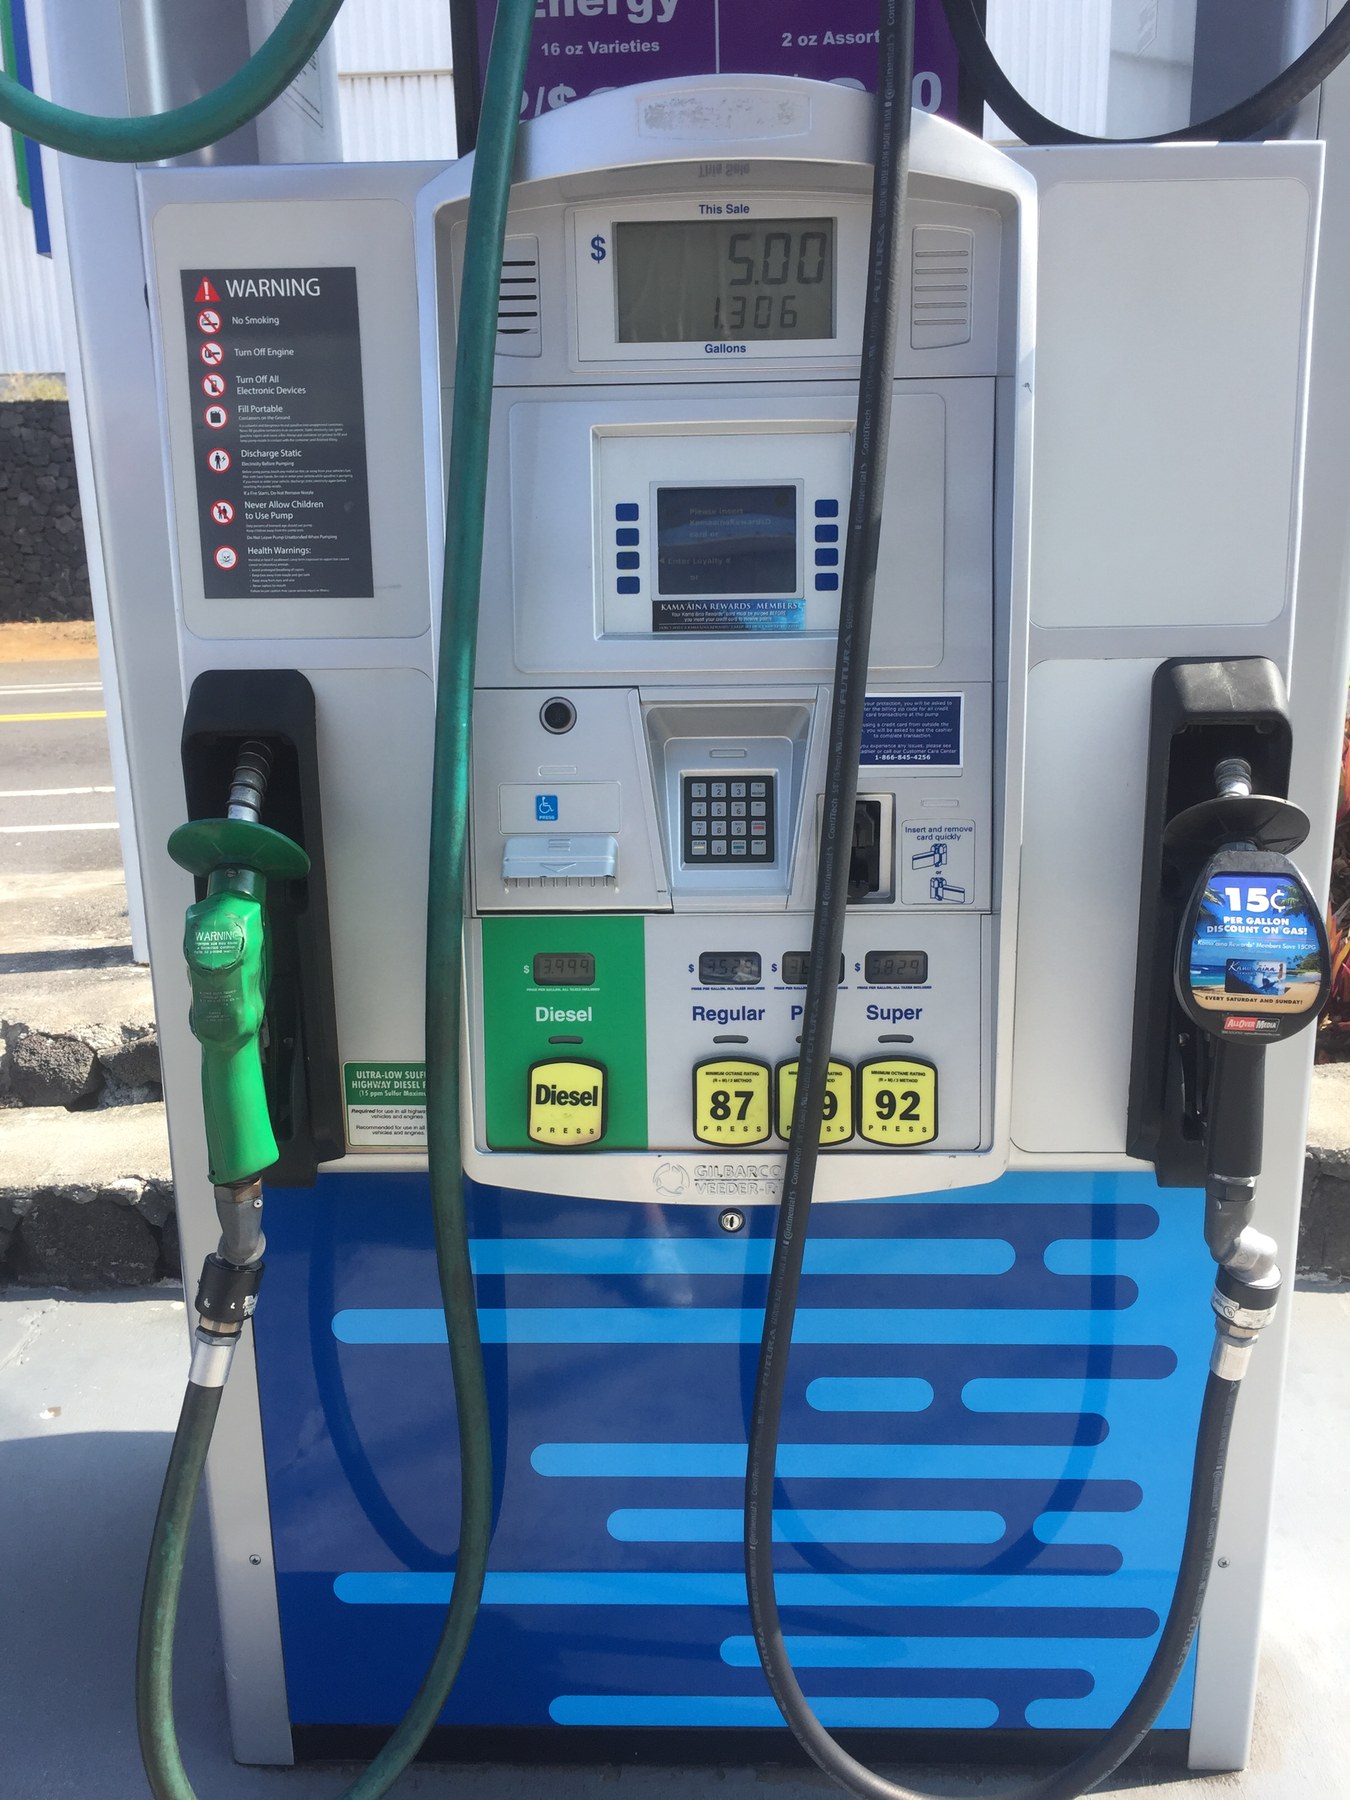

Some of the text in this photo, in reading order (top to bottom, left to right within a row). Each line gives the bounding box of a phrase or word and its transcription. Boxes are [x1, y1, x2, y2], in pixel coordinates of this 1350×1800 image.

[782, 29, 881, 47] 2 oz Assort
[541, 40, 660, 56] 16 oz Varieties
[699, 203, 749, 215] This Sale
[590, 234, 607, 264] $
[728, 231, 828, 286] 5.00
[226, 278, 320, 298] WARNING
[232, 316, 280, 326] No Smoking
[234, 347, 294, 358] Turn Off Engine
[704, 343, 747, 354] Gallons
[236, 375, 280, 384] Turn Off All
[237, 386, 307, 395] Electronic Devices
[238, 404, 283, 413] Fill Portable
[241, 449, 302, 459] Discharge Static
[244, 500, 324, 509] Never Allow Children
[245, 511, 294, 520] to Use Pump
[247, 547, 312, 556] Health Warnings:
[1225, 887, 1286, 913] 15¢
[1223, 916, 1290, 926] PER GALLON
[195, 930, 240, 941] WARNING
[1207, 925, 1308, 936] DISCOUNT ON GAS!
[523, 965, 530, 974] $
[688, 963, 695, 973] $
[771, 963, 778, 973] $
[854, 962, 861, 973] $
[535, 1006, 593, 1022] Diesel
[692, 1006, 765, 1025] Regular
[866, 1005, 923, 1024] Super
[356, 1070, 426, 1079] ULTRA-LOW SULF
[352, 1081, 391, 1089] HIGHWAY
[394, 1081, 420, 1089] DIESEL
[535, 1084, 599, 1107] Diesel
[709, 1090, 754, 1121] 87
[822, 1090, 838, 1121] 9
[875, 1089, 921, 1121] 92
[536, 1126, 595, 1135] PRESS
[868, 1125, 927, 1133] PRESS
[694, 1164, 783, 1178] GILBARCO
[694, 1182, 779, 1195] VEEDER-R
